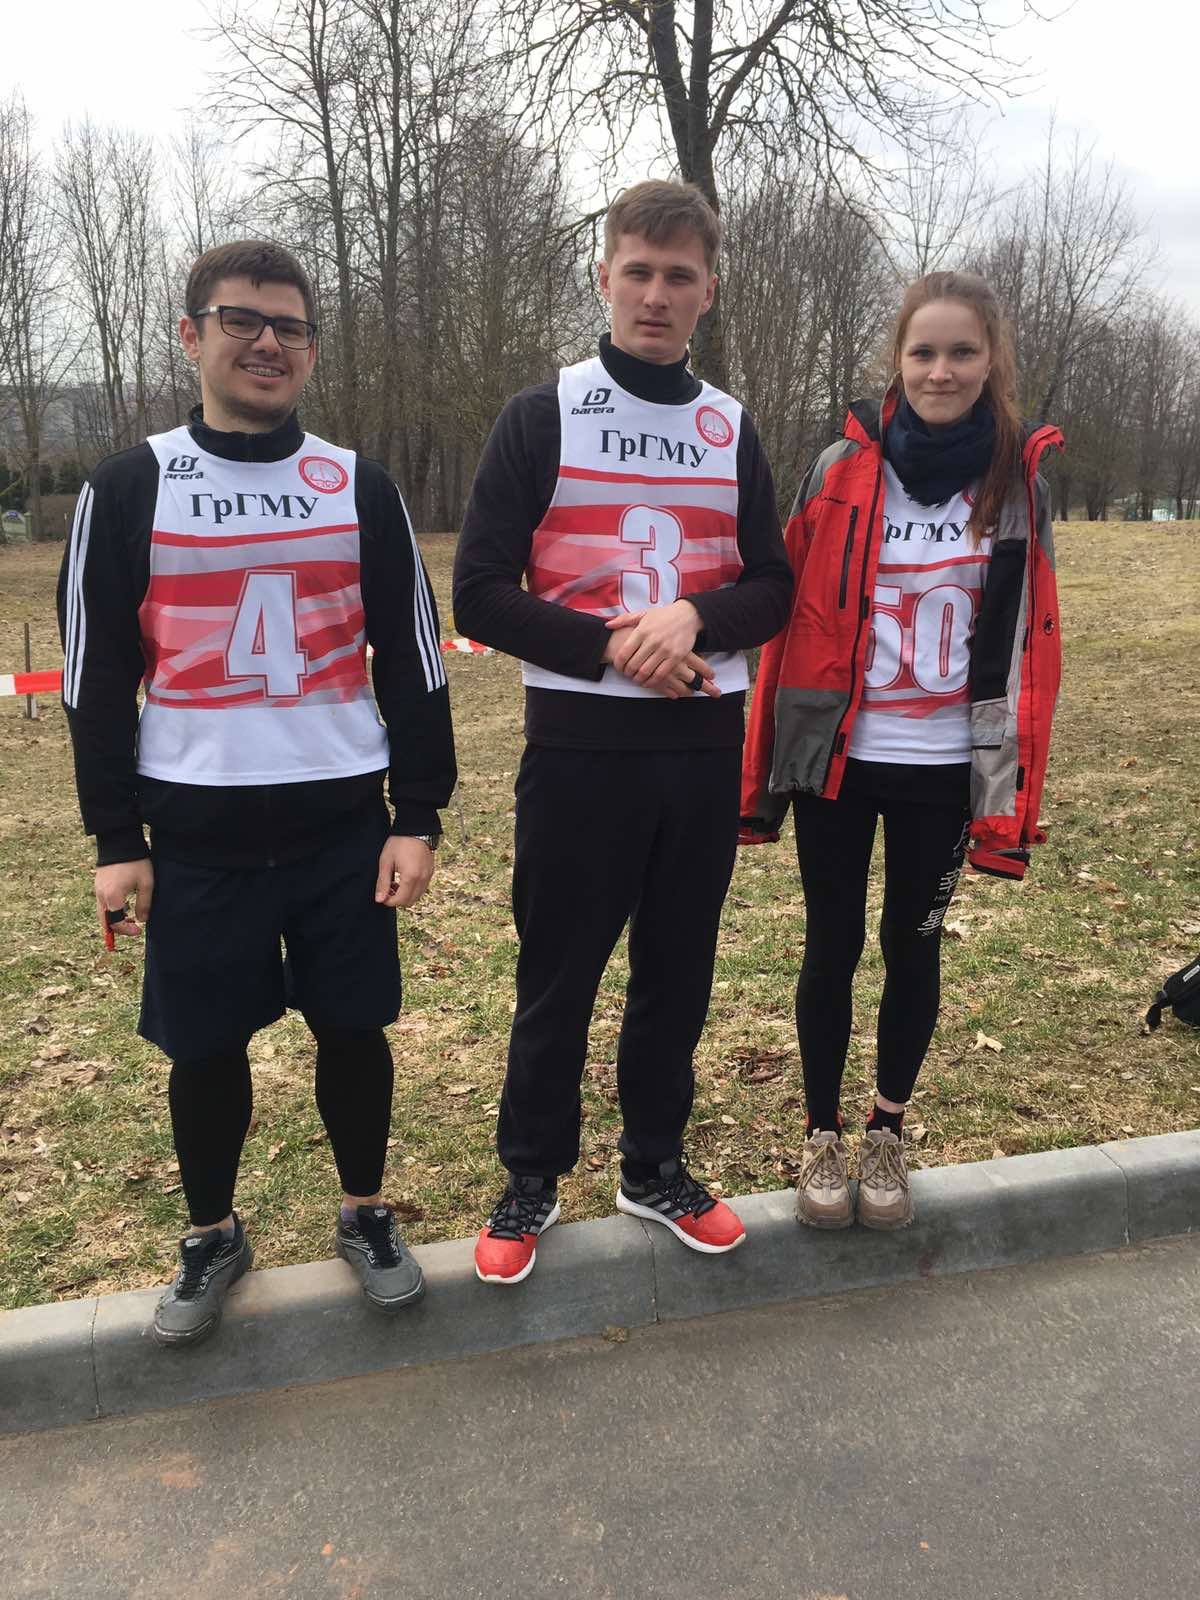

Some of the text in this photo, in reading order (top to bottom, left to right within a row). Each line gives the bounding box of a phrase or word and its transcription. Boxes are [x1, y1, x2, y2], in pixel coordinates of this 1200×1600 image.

[571, 407, 615, 415] barera
[600, 429, 708, 468] ГрГМУ
[163, 471, 204, 480] arera
[189, 493, 319, 524] ГрГМУ
[882, 514, 969, 543] рГМУ
[618, 504, 684, 614] 3
[224, 569, 308, 698] 4
